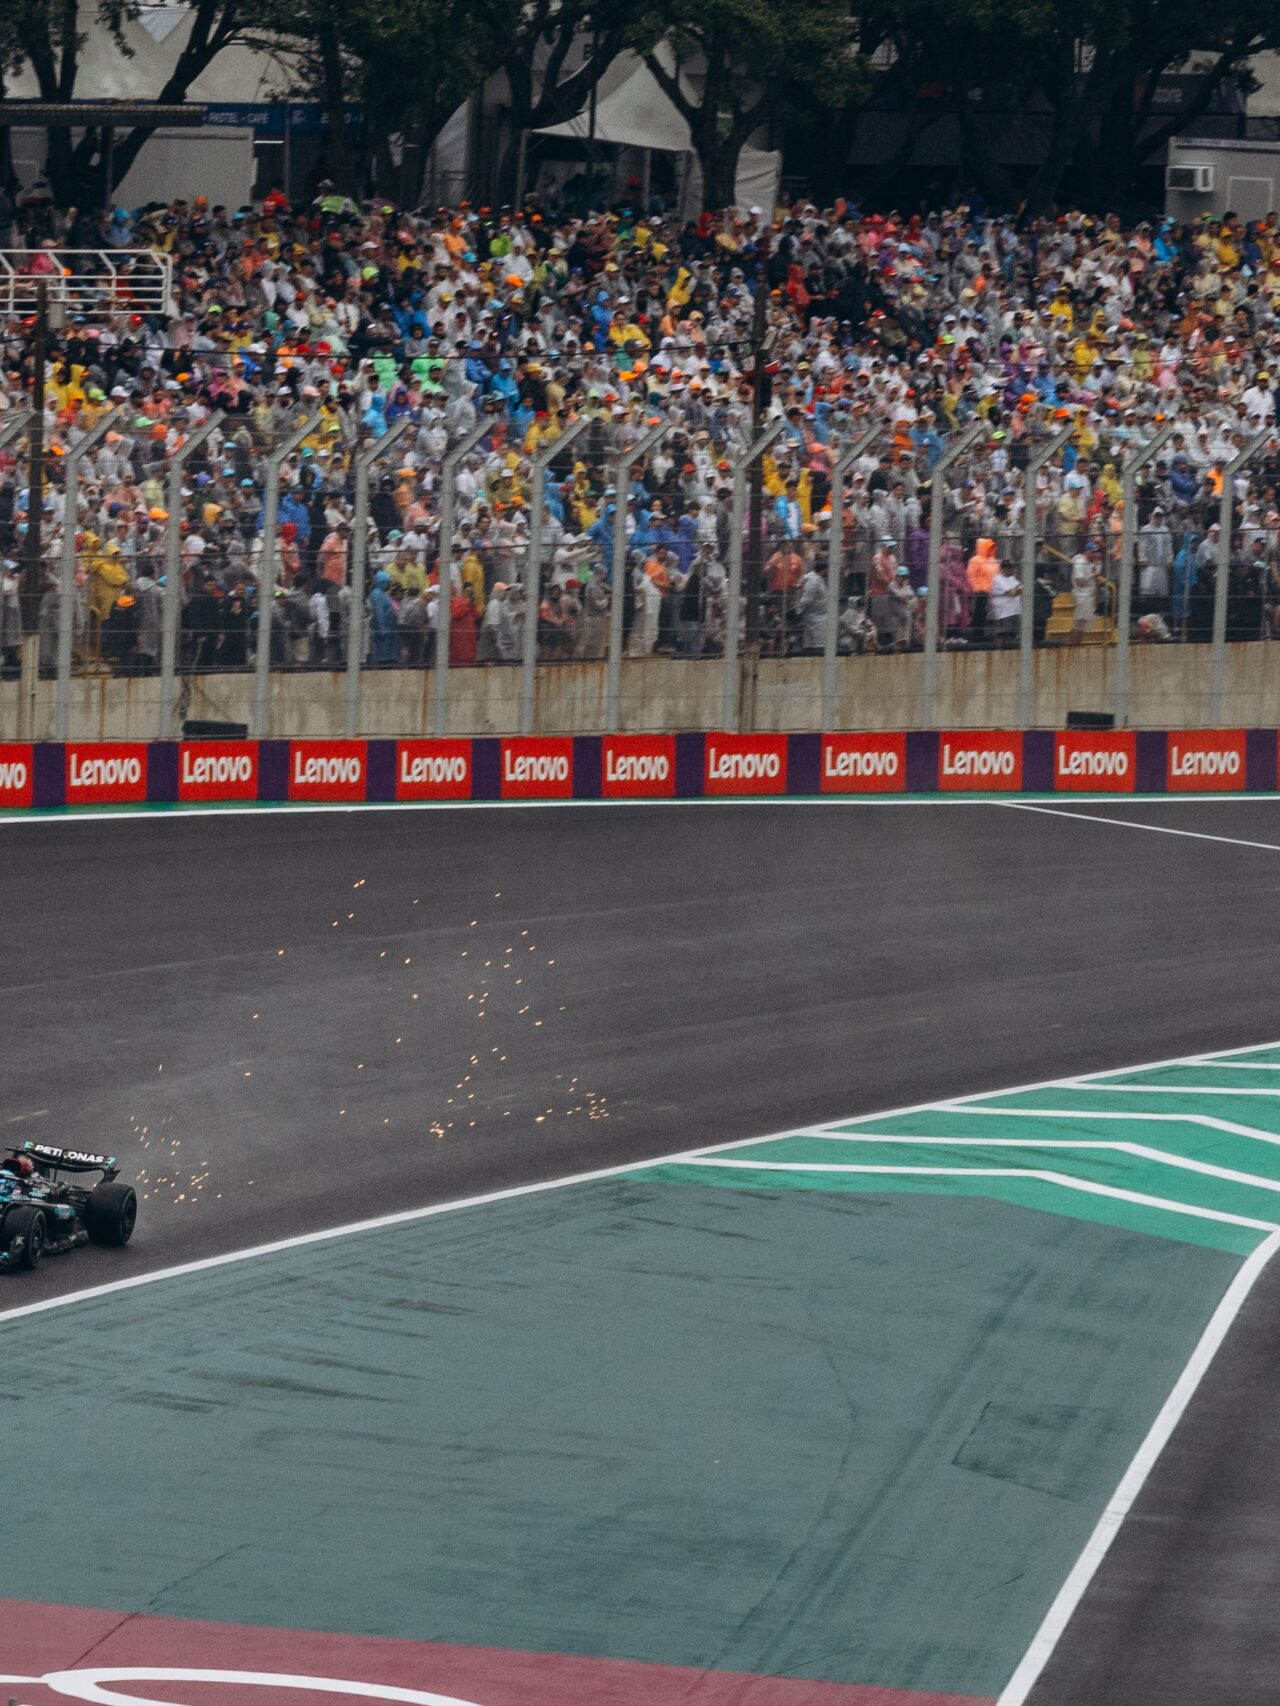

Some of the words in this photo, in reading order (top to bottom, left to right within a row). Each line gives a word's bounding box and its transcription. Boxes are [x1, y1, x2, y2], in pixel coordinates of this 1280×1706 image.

[70, 753, 141, 786] Lenovo
[182, 751, 252, 784] Lenovo
[294, 751, 361, 784] Lenovo
[401, 751, 466, 783] Lenovo
[505, 749, 569, 782] Lenovo
[606, 750, 669, 782] Lenovo
[709, 747, 780, 779] Lenovo
[825, 746, 899, 777] Lenovo
[942, 744, 1015, 776] Lenovo
[1058, 744, 1128, 776] Lenovo
[1171, 746, 1241, 776] Lenovo
